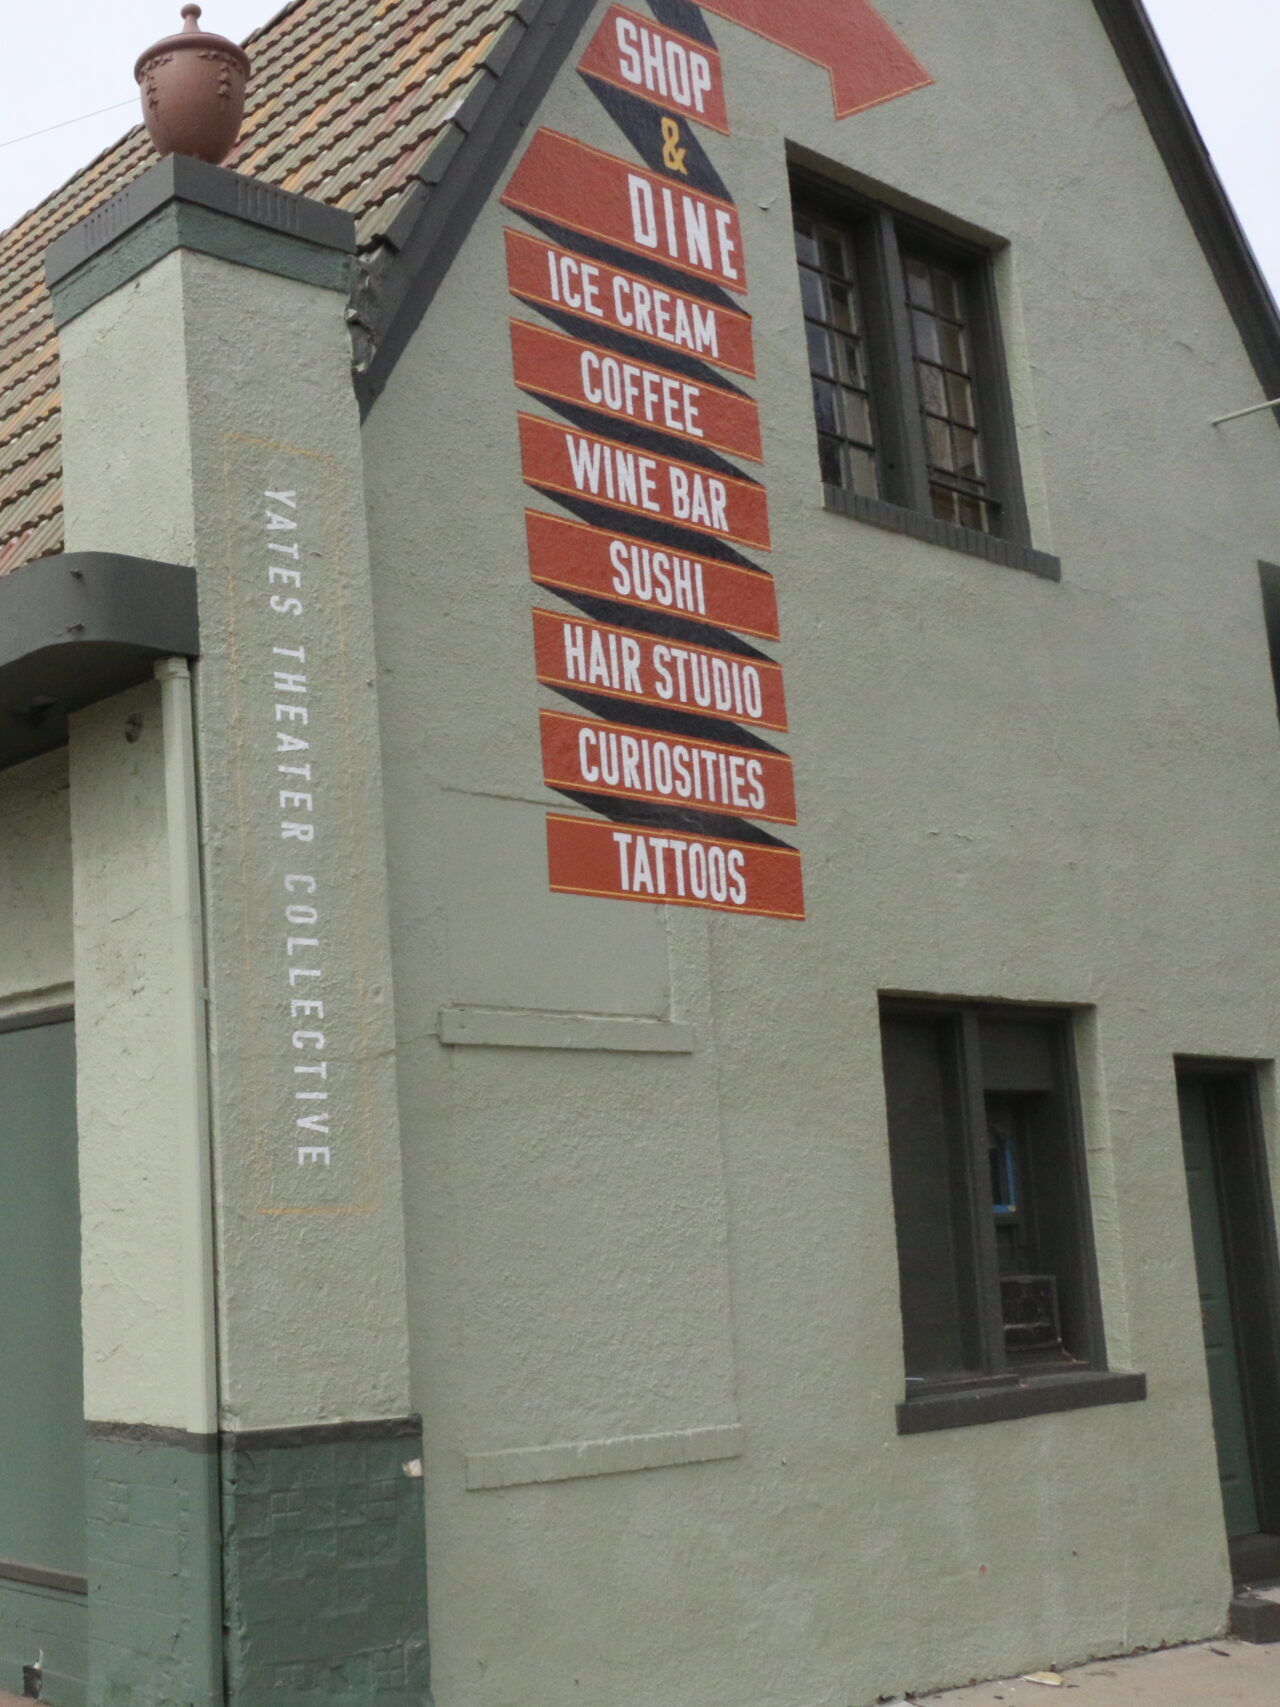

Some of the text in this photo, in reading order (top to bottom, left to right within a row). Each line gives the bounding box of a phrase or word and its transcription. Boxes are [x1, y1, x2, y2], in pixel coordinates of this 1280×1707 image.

[616, 16, 711, 113] SHOP
[661, 117, 688, 176] &
[627, 173, 738, 281] DINE
[547, 250, 719, 358] ICE CREAM
[580, 350, 704, 437] COFFEE
[565, 434, 729, 532] WINE BAR
[609, 540, 706, 615] SUSHI
[563, 623, 762, 719] HAIR STUDIO
[579, 727, 765, 809] CURIOSITIES
[263, 490, 331, 1167] YATES THEATER COLLECTIVE
[613, 832, 747, 905] TATTOOS
